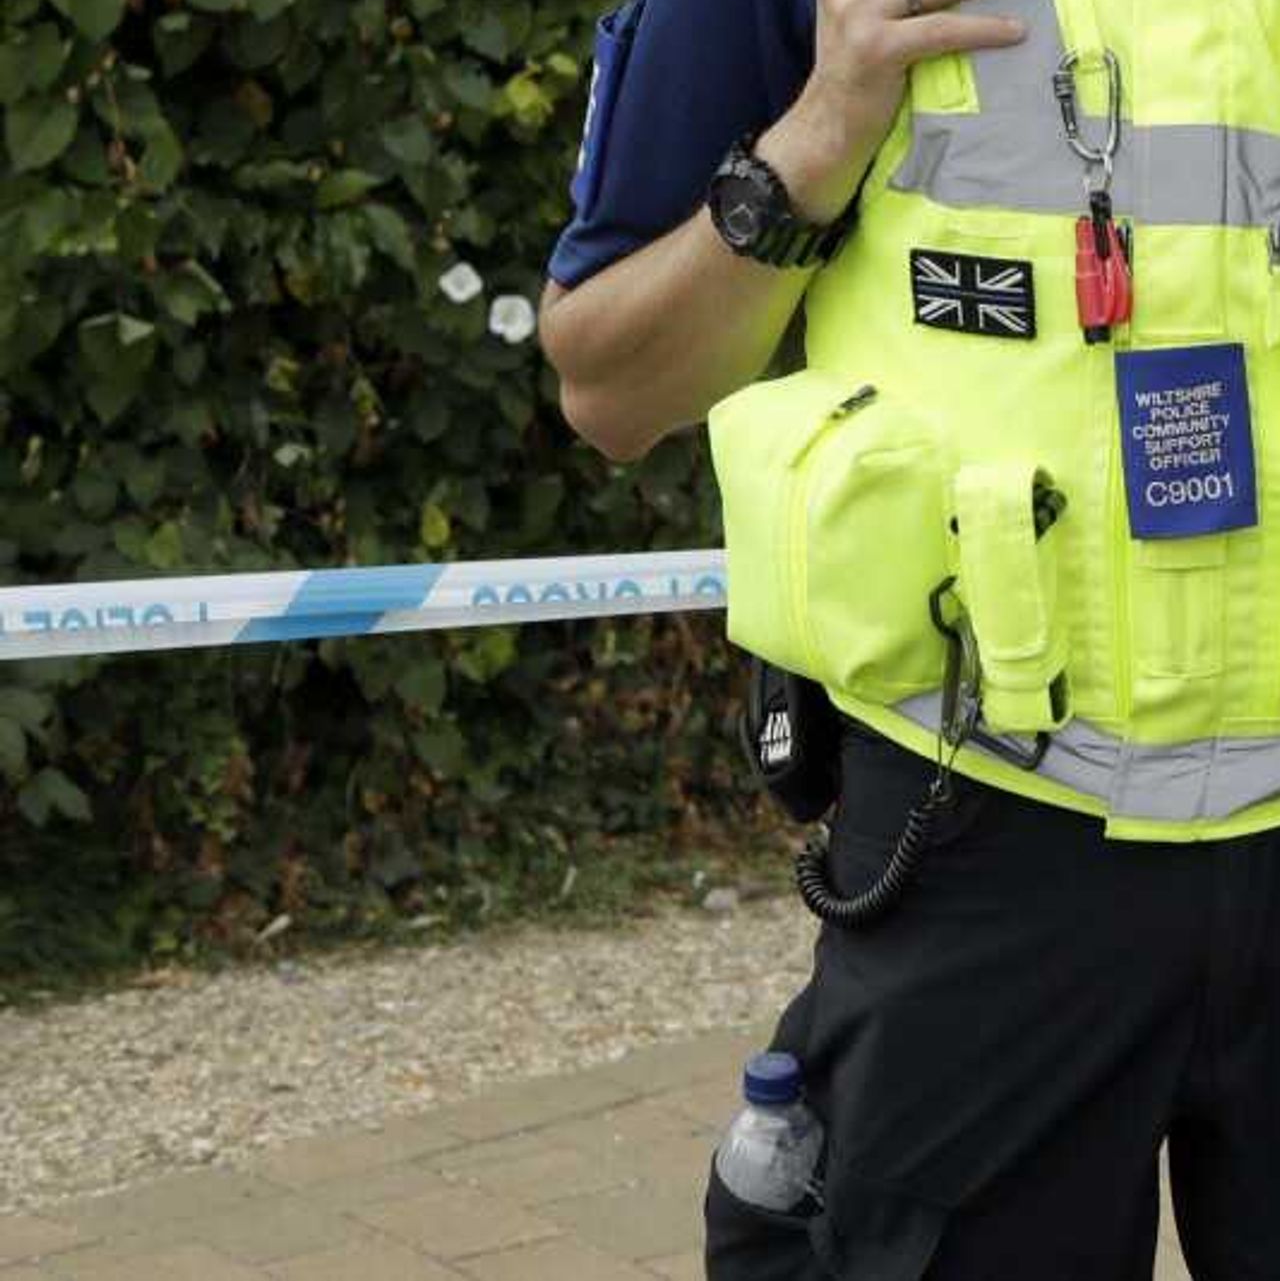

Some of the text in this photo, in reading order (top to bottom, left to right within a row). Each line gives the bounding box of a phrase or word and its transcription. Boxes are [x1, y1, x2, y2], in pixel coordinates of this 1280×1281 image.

[1135, 381, 1223, 407] WILTSHIRE
[1151, 402, 1211, 421] POLICE
[1132, 413, 1230, 440] COMMUNITY
[1145, 431, 1223, 455] SUPPORT
[1150, 449, 1221, 471] OFFICER
[1145, 472, 1234, 508] C9001
